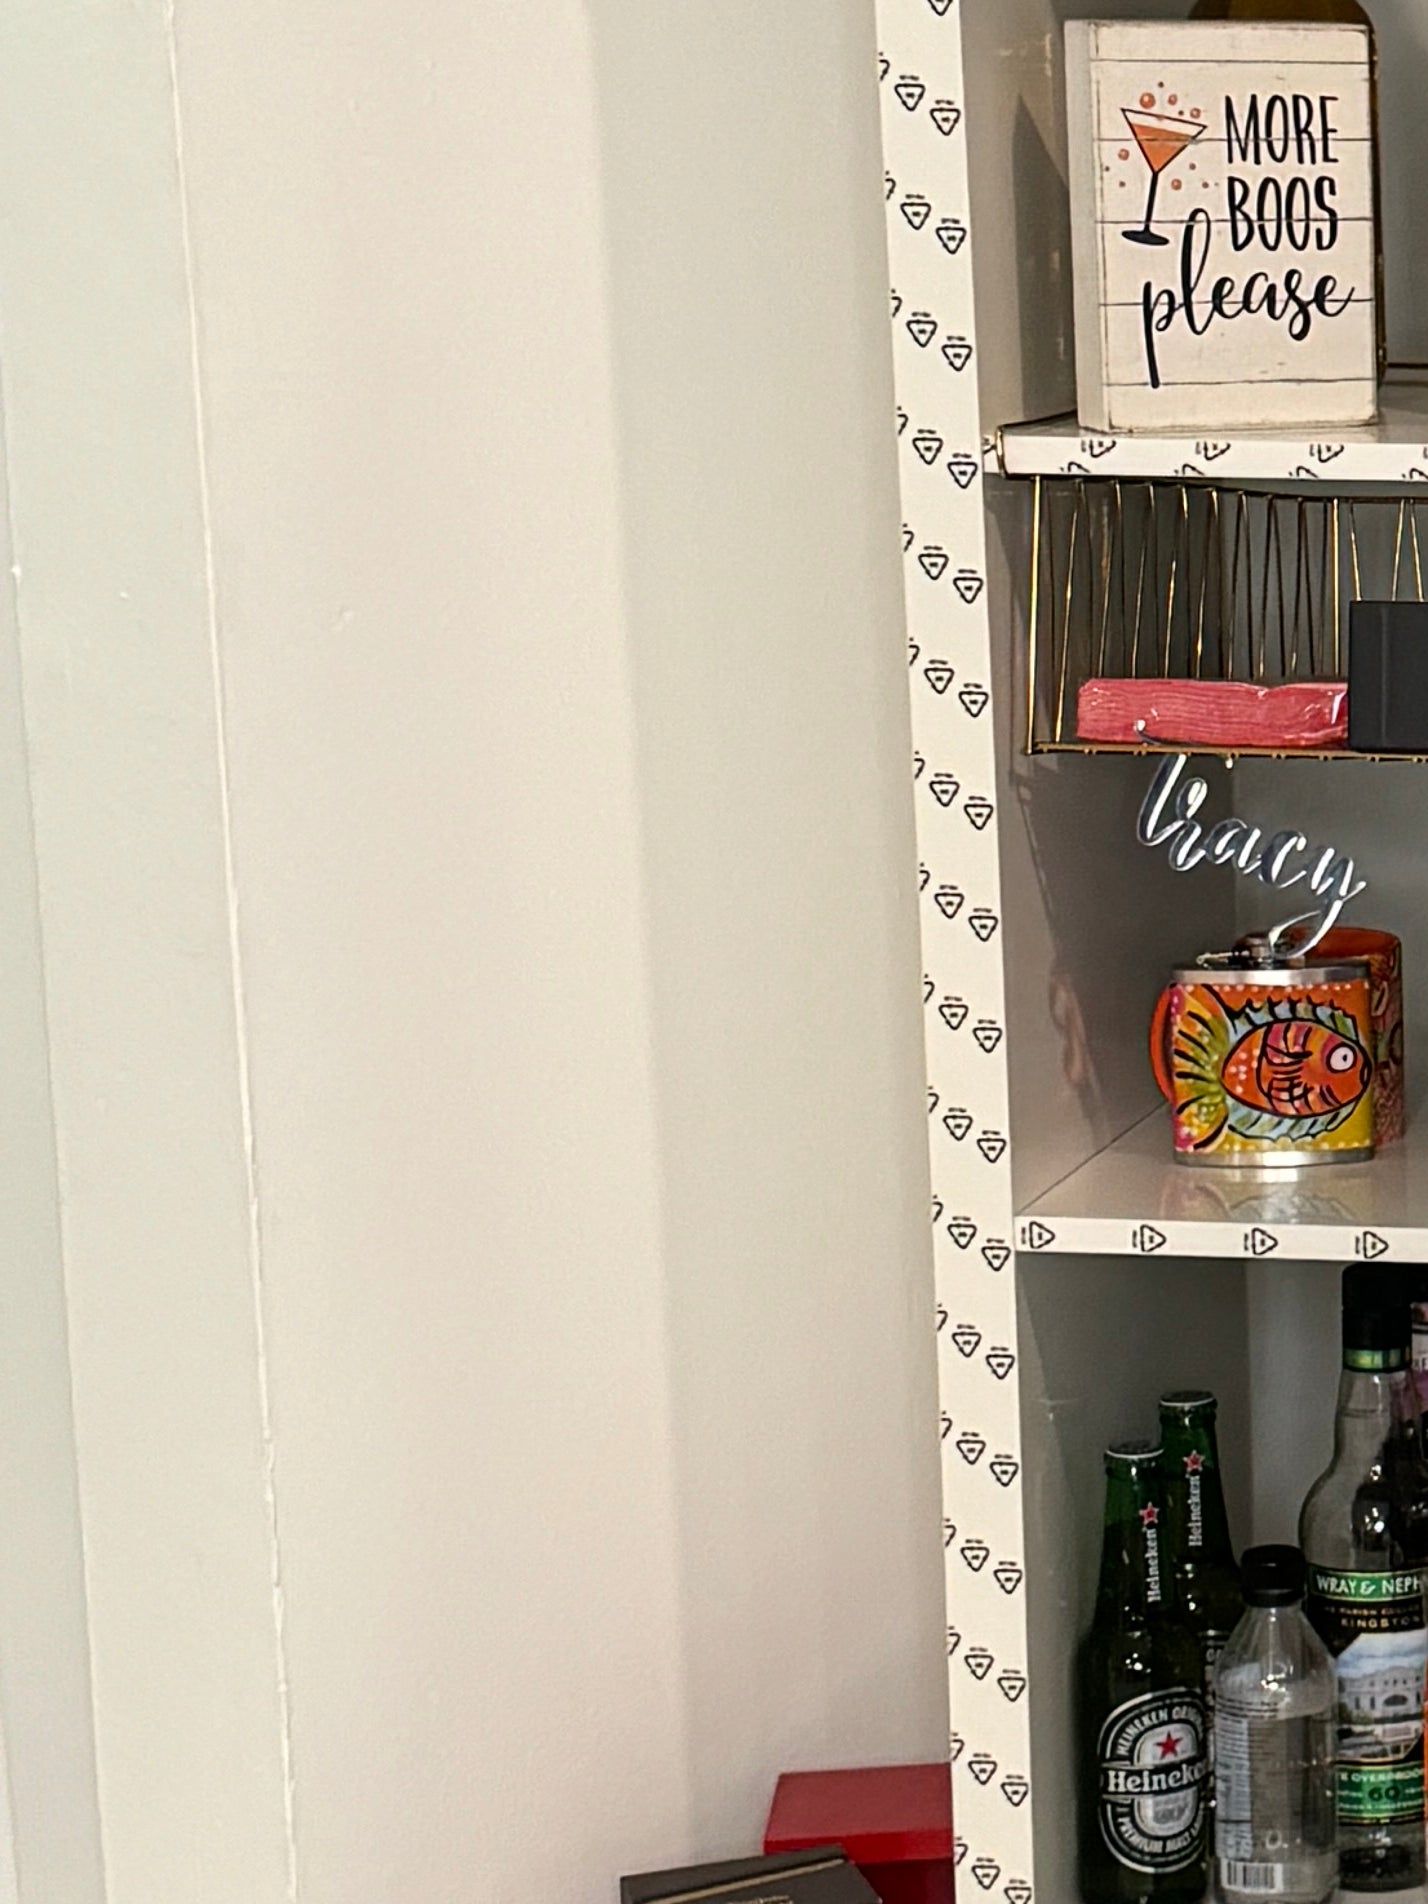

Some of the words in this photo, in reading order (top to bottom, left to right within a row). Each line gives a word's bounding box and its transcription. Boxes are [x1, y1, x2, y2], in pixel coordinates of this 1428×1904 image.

[1224, 94, 1339, 165] MORE
[1227, 175, 1339, 251] BOOS
[1143, 207, 1355, 389] please
[1144, 1527, 1162, 1603] Heineken
[1316, 1574, 1357, 1595] WRAY
[1381, 1576, 1421, 1595] NEPH
